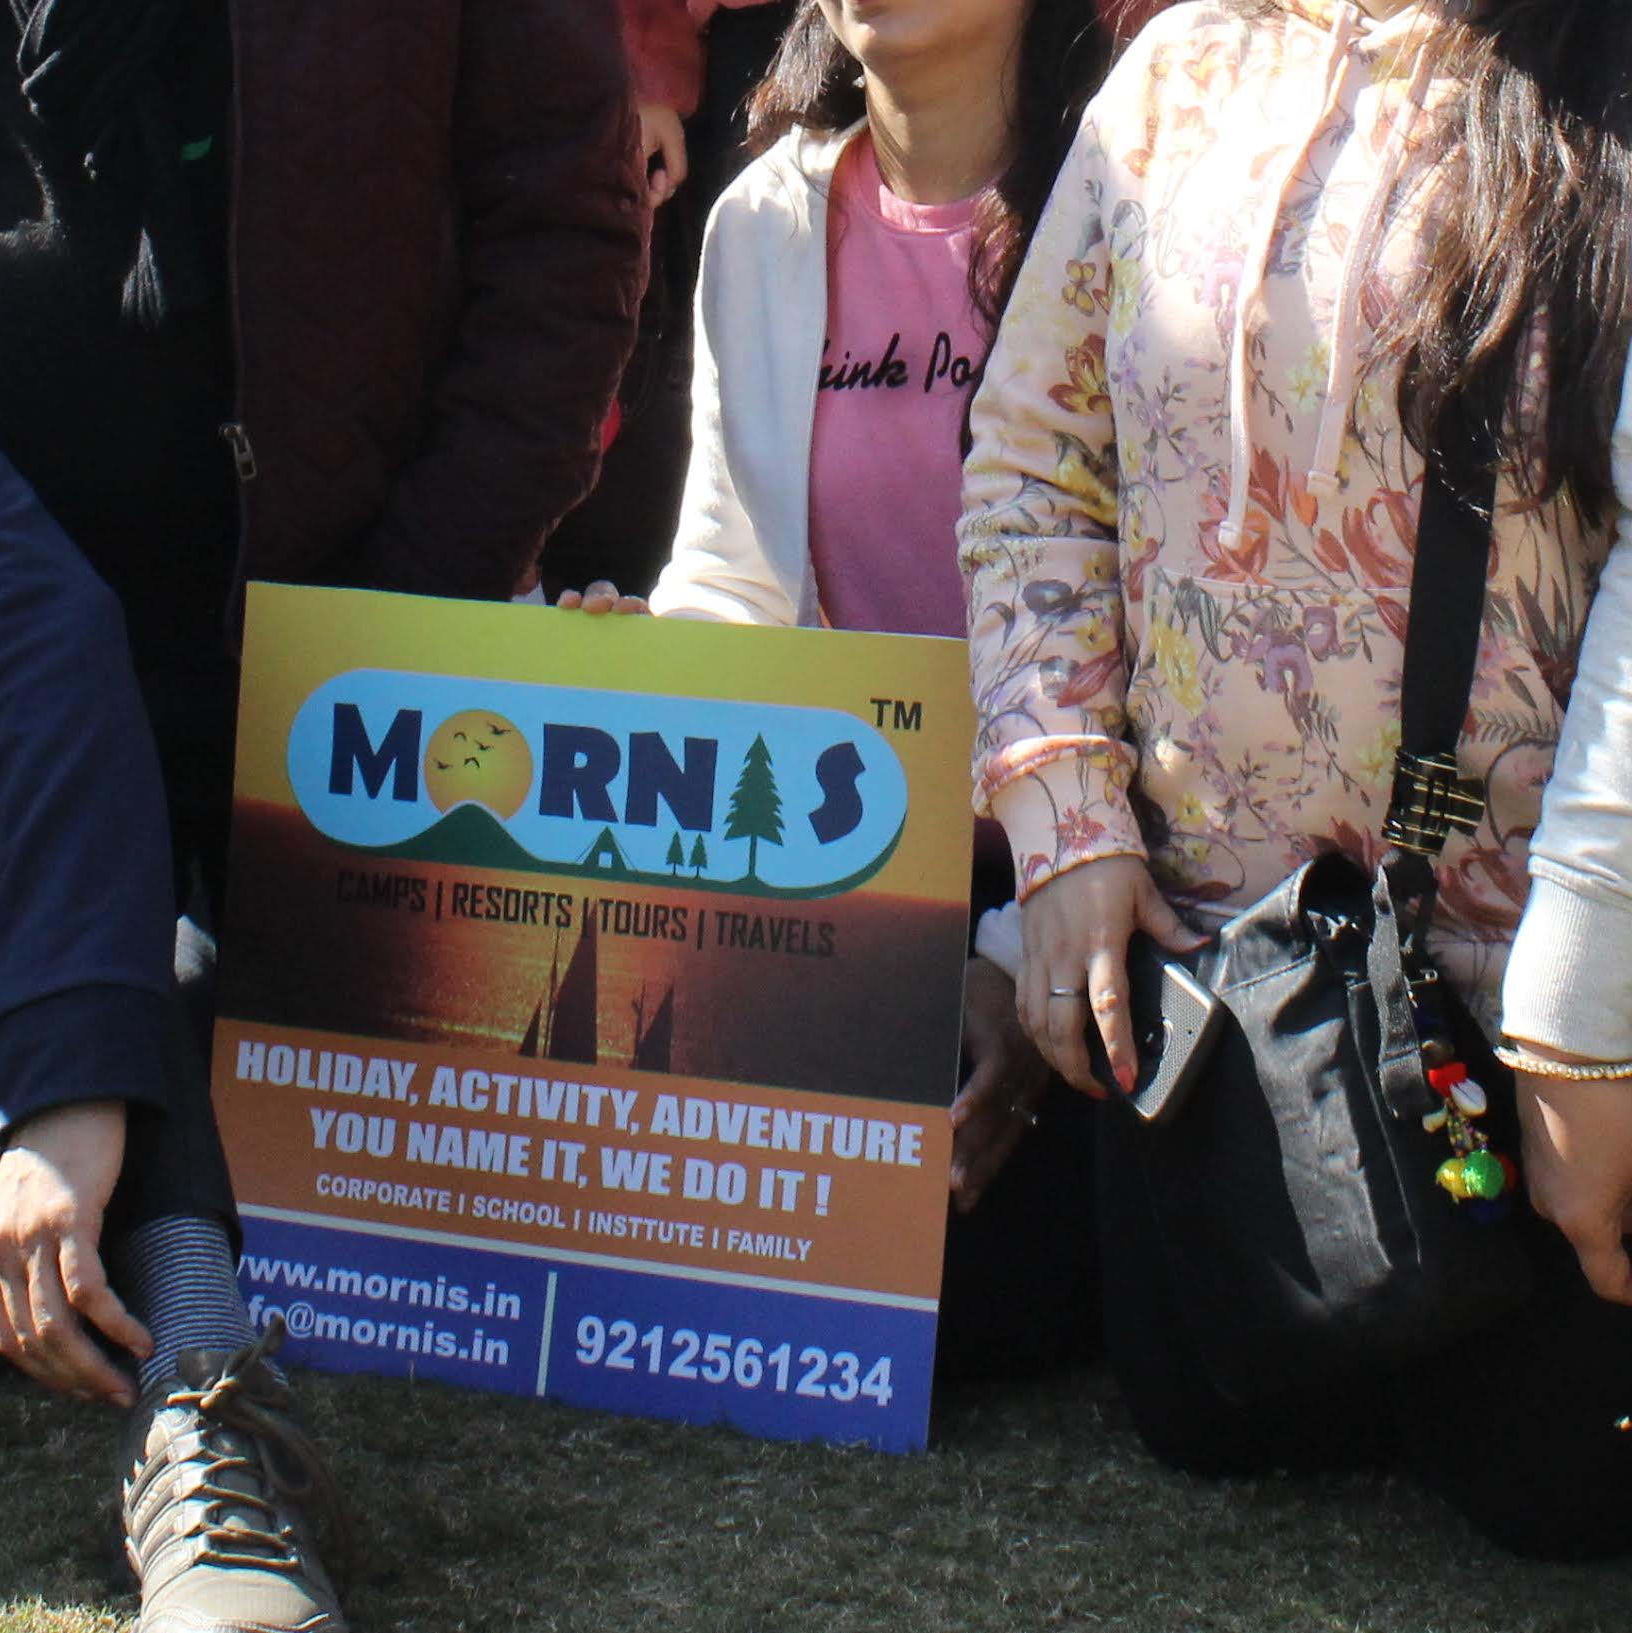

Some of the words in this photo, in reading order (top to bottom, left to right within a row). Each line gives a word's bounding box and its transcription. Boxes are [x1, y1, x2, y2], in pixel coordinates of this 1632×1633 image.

[869, 697, 923, 732] TM
[336, 870, 427, 914] CAMPS
[451, 881, 573, 928] RESORTS
[597, 899, 688, 942] TOURS
[713, 910, 835, 957] TRAVELS
[236, 1040, 420, 1107] HOLIDAY,
[428, 1065, 641, 1136] ACTIVITY,
[649, 1093, 924, 1168] ADVENTURE
[309, 1107, 397, 1159] YOU
[406, 1121, 532, 1176] NAME
[540, 1139, 589, 1189] IT,
[600, 1146, 673, 1196] WE
[682, 1158, 749, 1206] DO
[758, 1167, 807, 1213] IT
[316, 1172, 452, 1214] CORPORATE
[472, 1195, 566, 1229] SCHOOL
[588, 1211, 705, 1248] INSTTUTE
[726, 1229, 814, 1261] FAMILY
[575, 1315, 894, 1407] 9212561234
